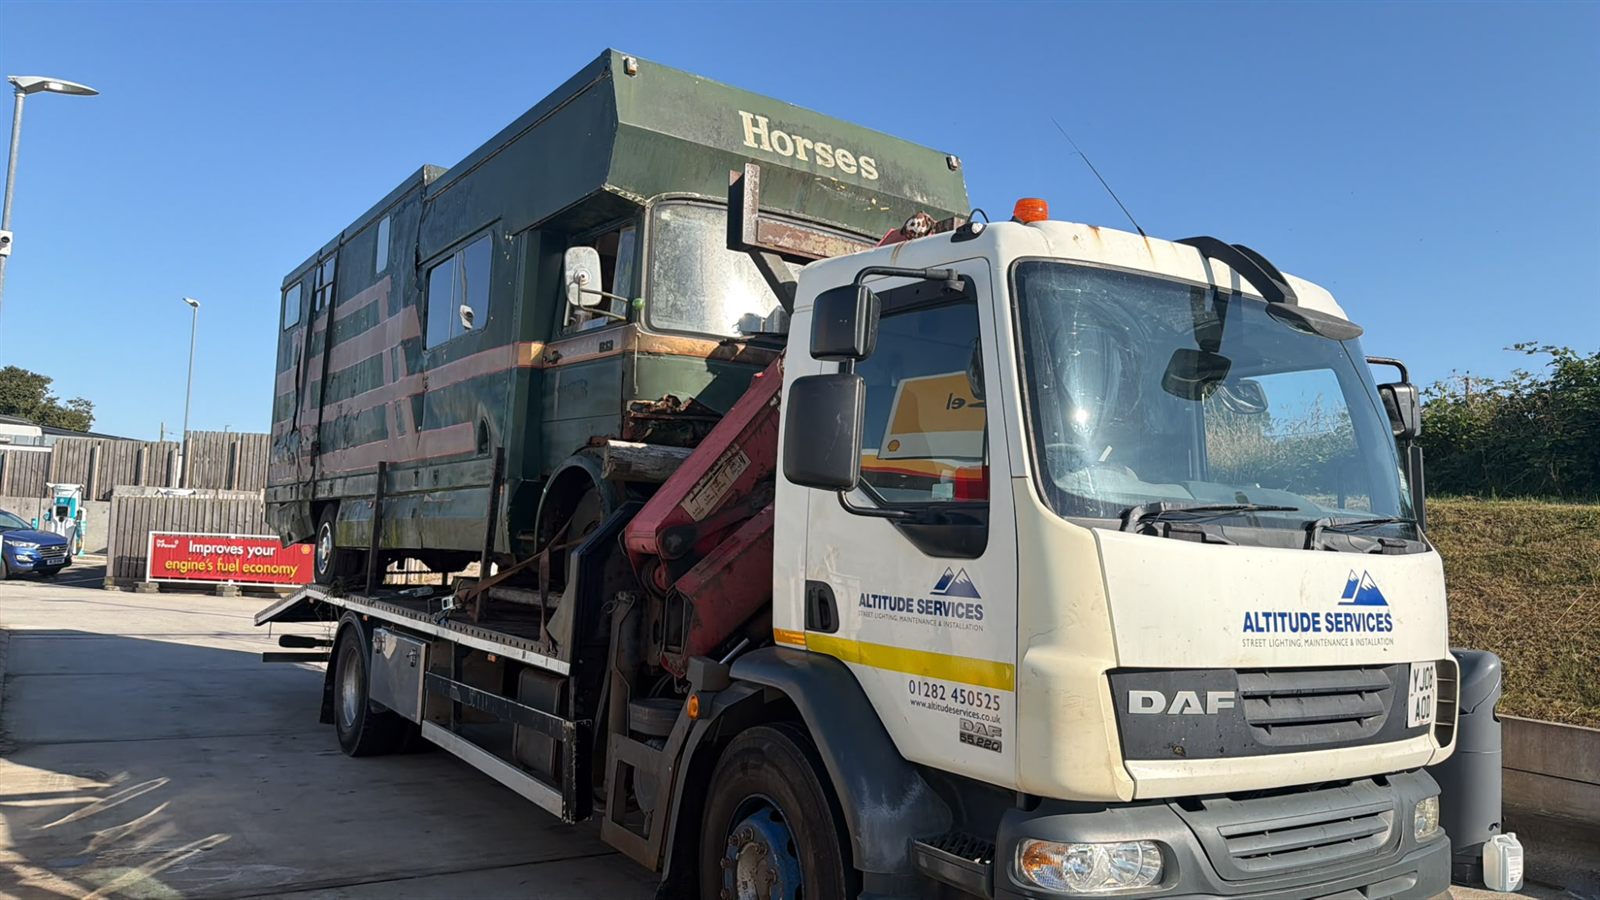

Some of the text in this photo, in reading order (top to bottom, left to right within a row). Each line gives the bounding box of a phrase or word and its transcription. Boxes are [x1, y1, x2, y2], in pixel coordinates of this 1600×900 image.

[738, 110, 879, 180] Horses
[189, 540, 276, 559] Improves your
[165, 558, 298, 577] engine's fuel economy
[859, 593, 984, 621] ALTITUDE SERVICES
[900, 615, 937, 627] MAINTENANCE
[943, 621, 984, 632] INSTALLATION
[1243, 611, 1393, 633] ALTITUDE SERVICES
[1242, 638, 1266, 647] STREET
[1269, 638, 1303, 648] LIGHTING,
[1304, 638, 1348, 647] MAINTENANCE
[1355, 638, 1394, 647] INSTALLATION
[909, 680, 1001, 711] 01282 450525
[1128, 690, 1235, 715] DAF
[910, 699, 1001, 723] www.altitudeservices.co.uk
[959, 717, 1002, 738] DAF
